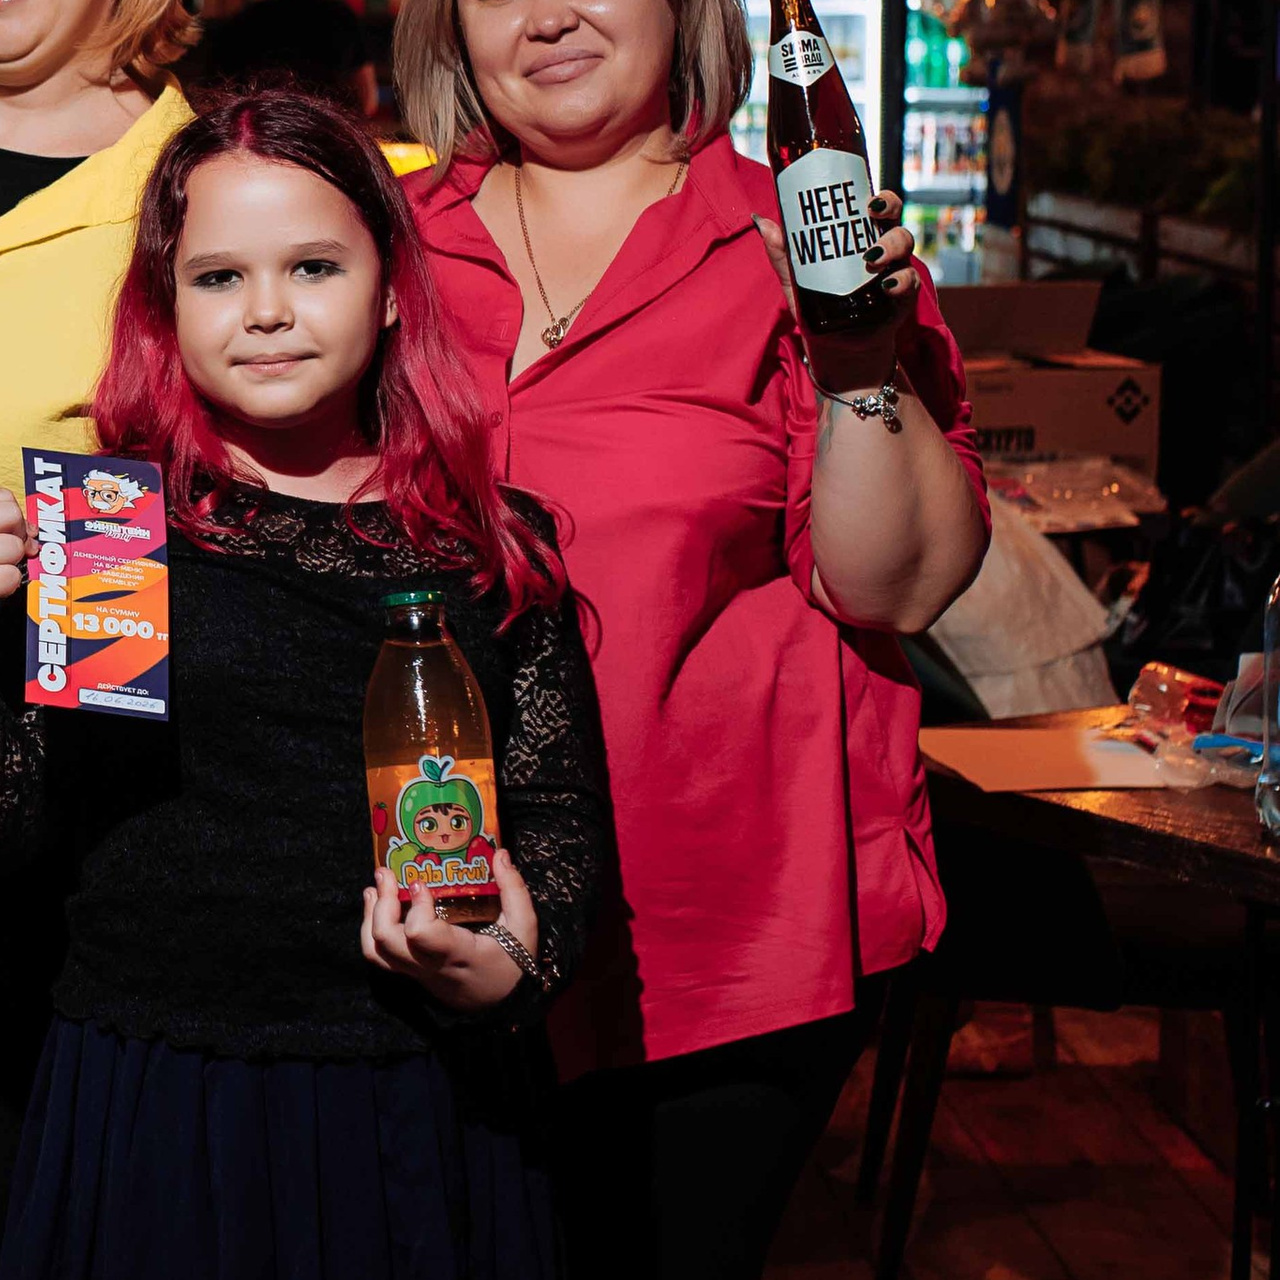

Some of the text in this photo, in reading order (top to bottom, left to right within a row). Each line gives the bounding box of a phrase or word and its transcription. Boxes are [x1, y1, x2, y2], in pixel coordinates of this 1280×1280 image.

[781, 38, 821, 58] SIMA
[797, 180, 860, 226] HEFE
[791, 217, 878, 266] WEIZEN
[73, 551, 117, 563] ДЕНЕЖНЫЙ
[33, 456, 68, 693] СЕРТИФИКАТ
[110, 608, 140, 618] СУММУ
[73, 613, 100, 632] 13
[103, 616, 154, 639] 000
[97, 682, 136, 694] ДЕЙСТВУЕТ
[446, 859, 488, 882] Fruit
